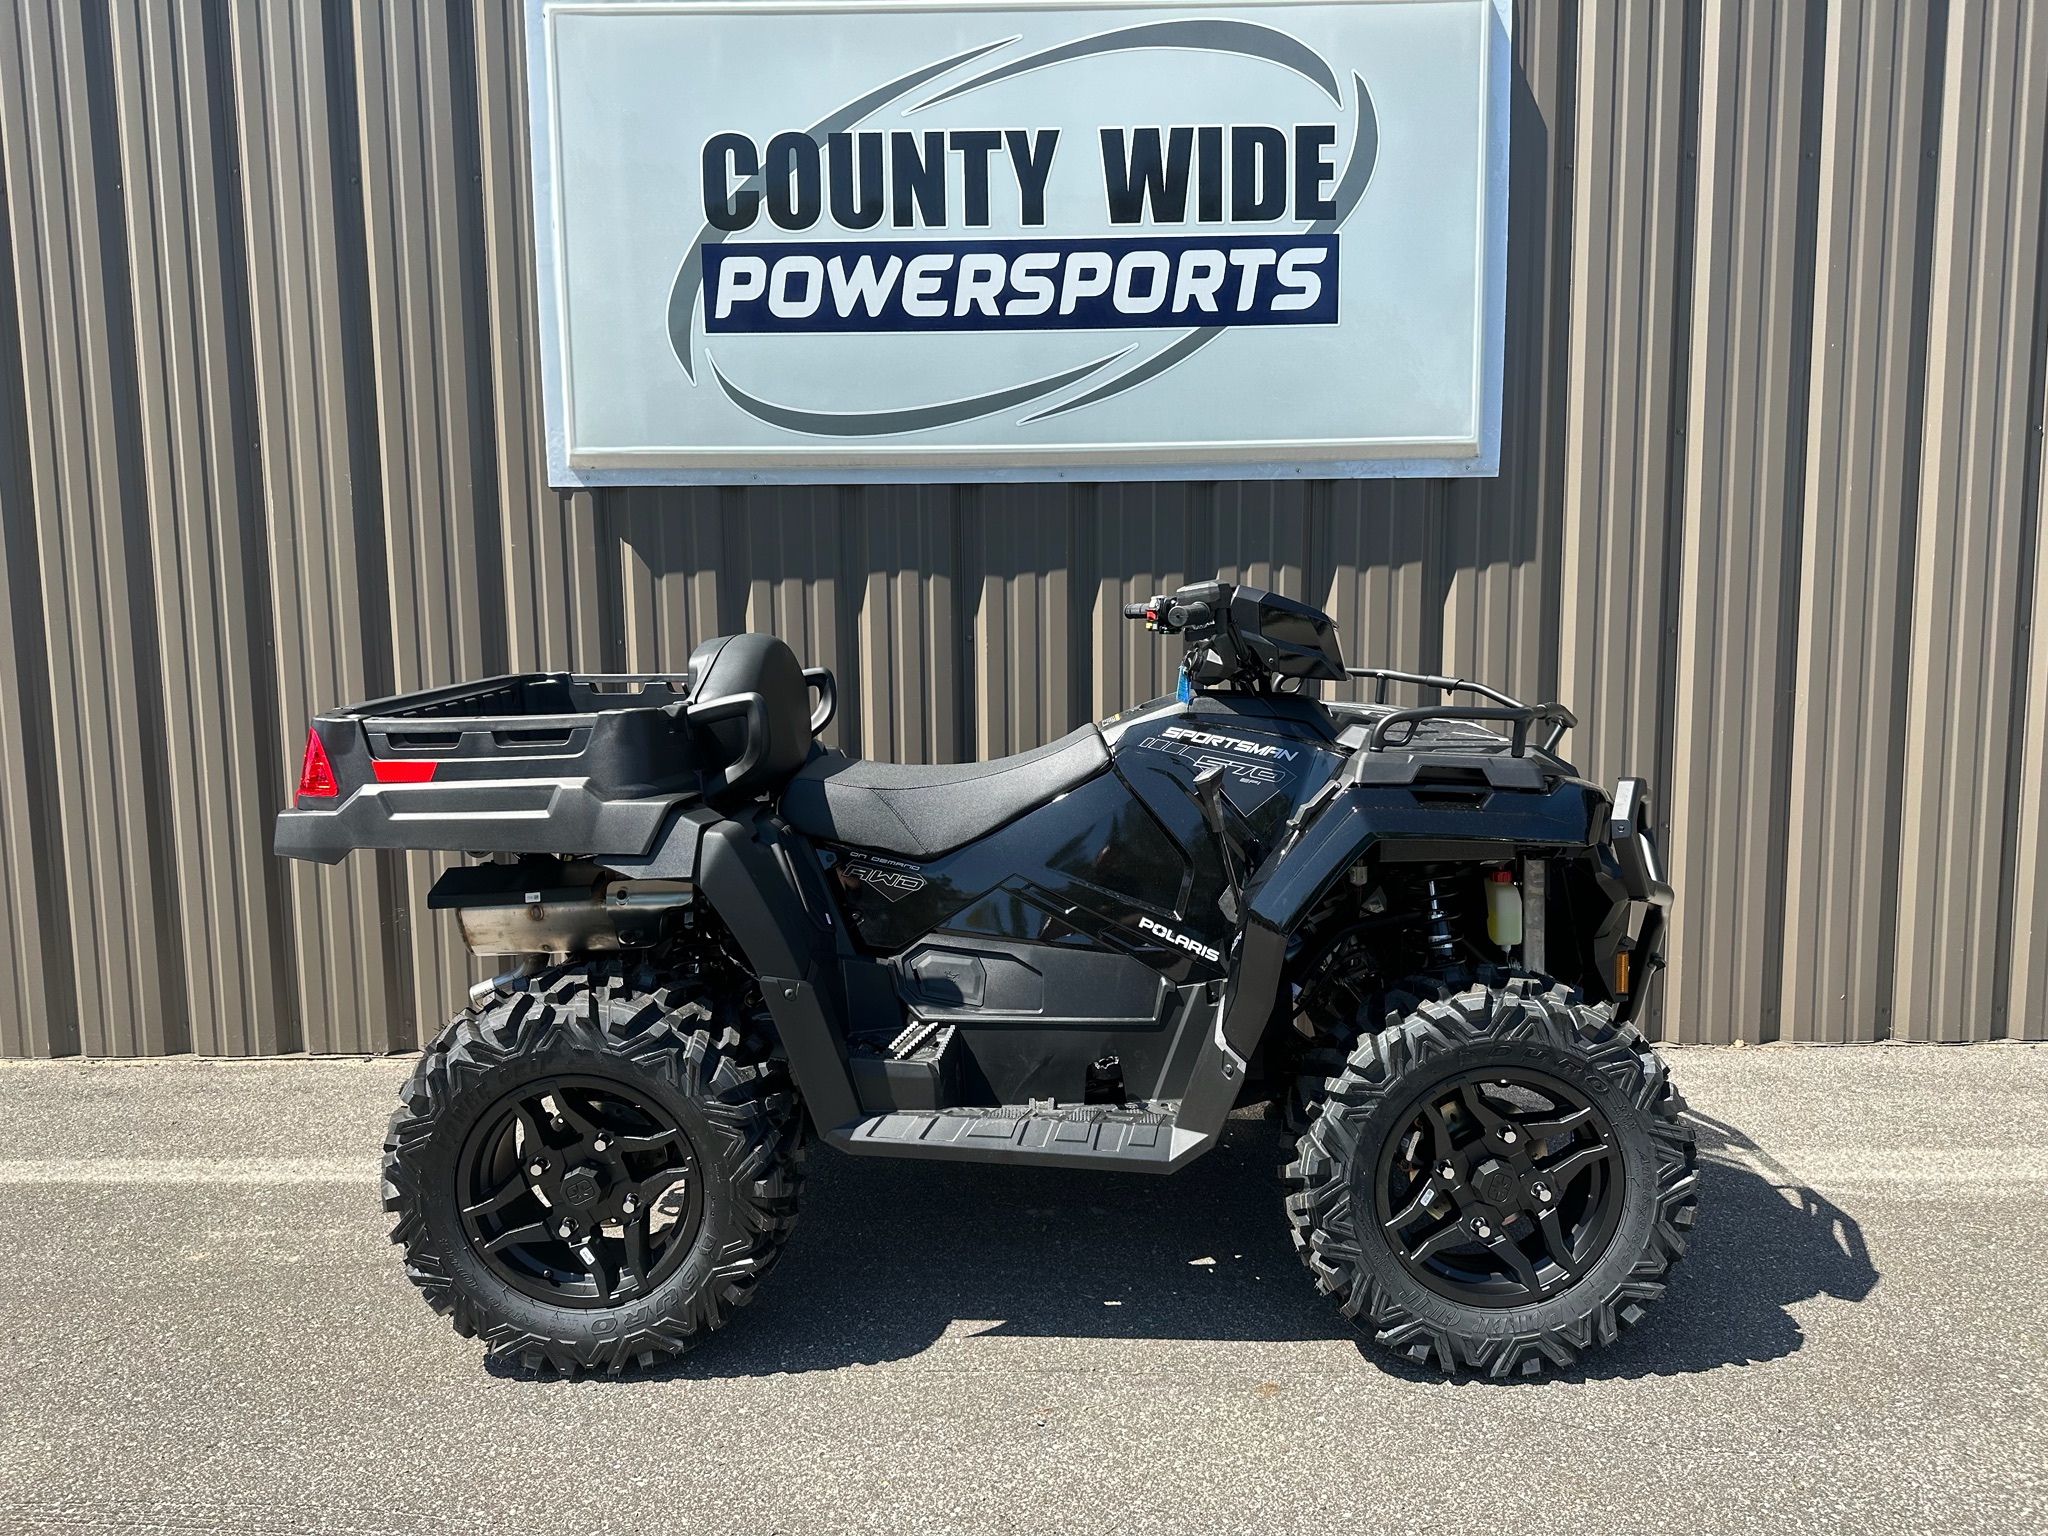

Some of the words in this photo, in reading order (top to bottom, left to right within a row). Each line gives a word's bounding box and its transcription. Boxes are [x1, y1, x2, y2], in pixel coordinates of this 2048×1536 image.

[702, 130, 1062, 230] COUNTY
[1099, 125, 1337, 225] WIDE
[714, 247, 1328, 320] POWERSPORTS
[1161, 726, 1299, 762] SPORTSMAN
[842, 864, 925, 892] AWD
[871, 856, 921, 871] DEMAND
[1138, 916, 1220, 962] POLARIS
[590, 1260, 700, 1336] DURO
